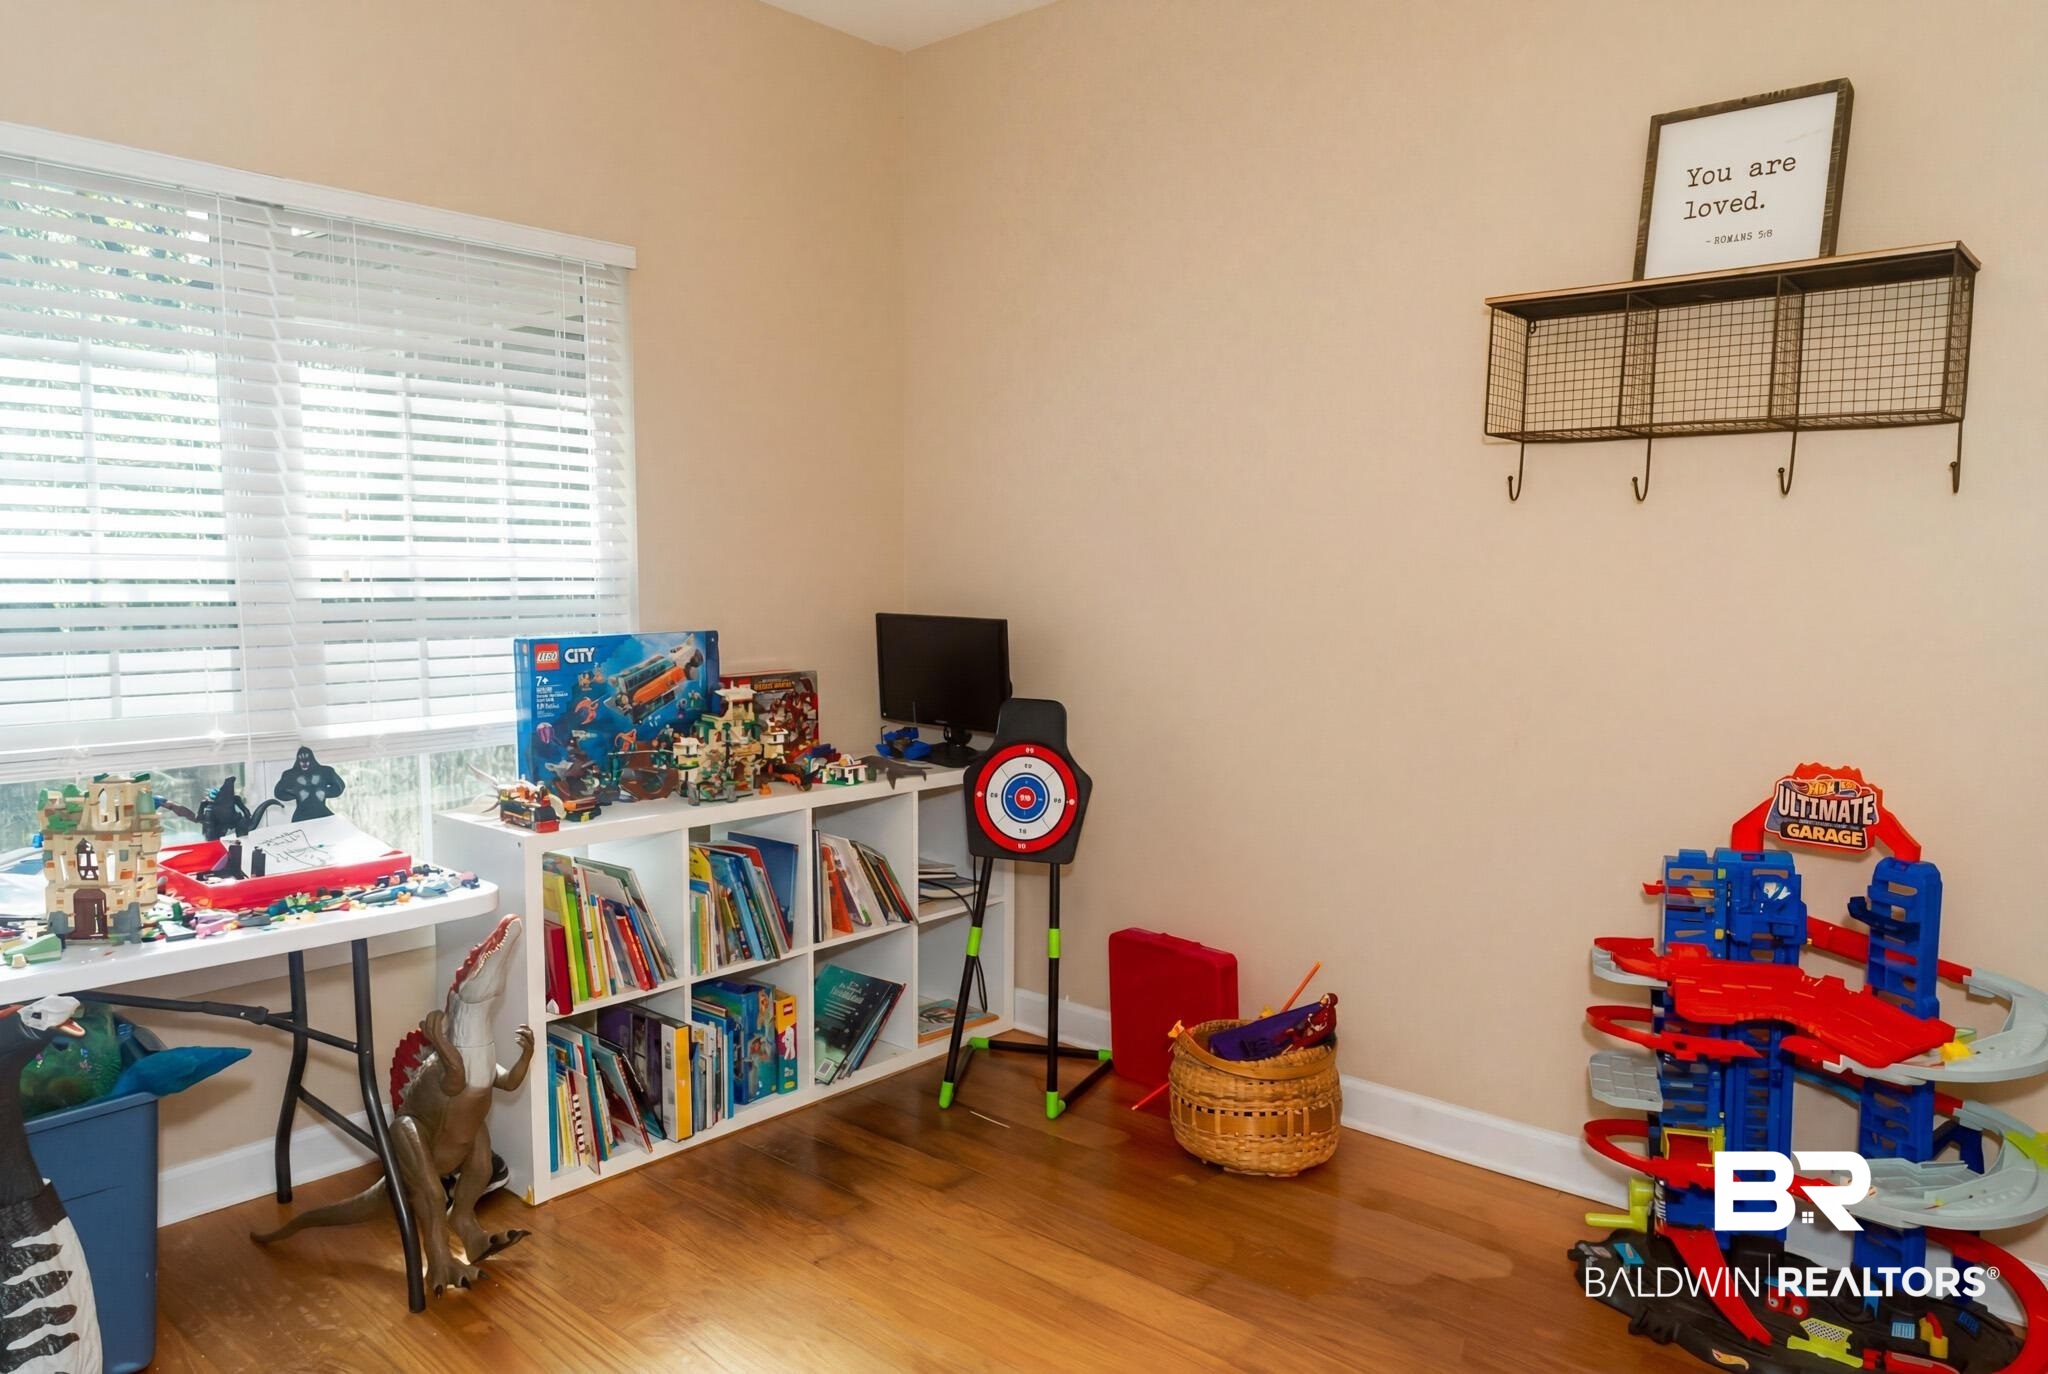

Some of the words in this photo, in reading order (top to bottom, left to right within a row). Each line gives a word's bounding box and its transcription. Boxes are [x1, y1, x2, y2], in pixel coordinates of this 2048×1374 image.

[1687, 166, 1732, 188] You
[1749, 156, 1797, 177] are
[1683, 190, 1766, 220] loved.
[564, 647, 595, 664] CITY
[1779, 785, 1874, 825] ULTIMATE
[1786, 823, 1864, 846] GARAGE
